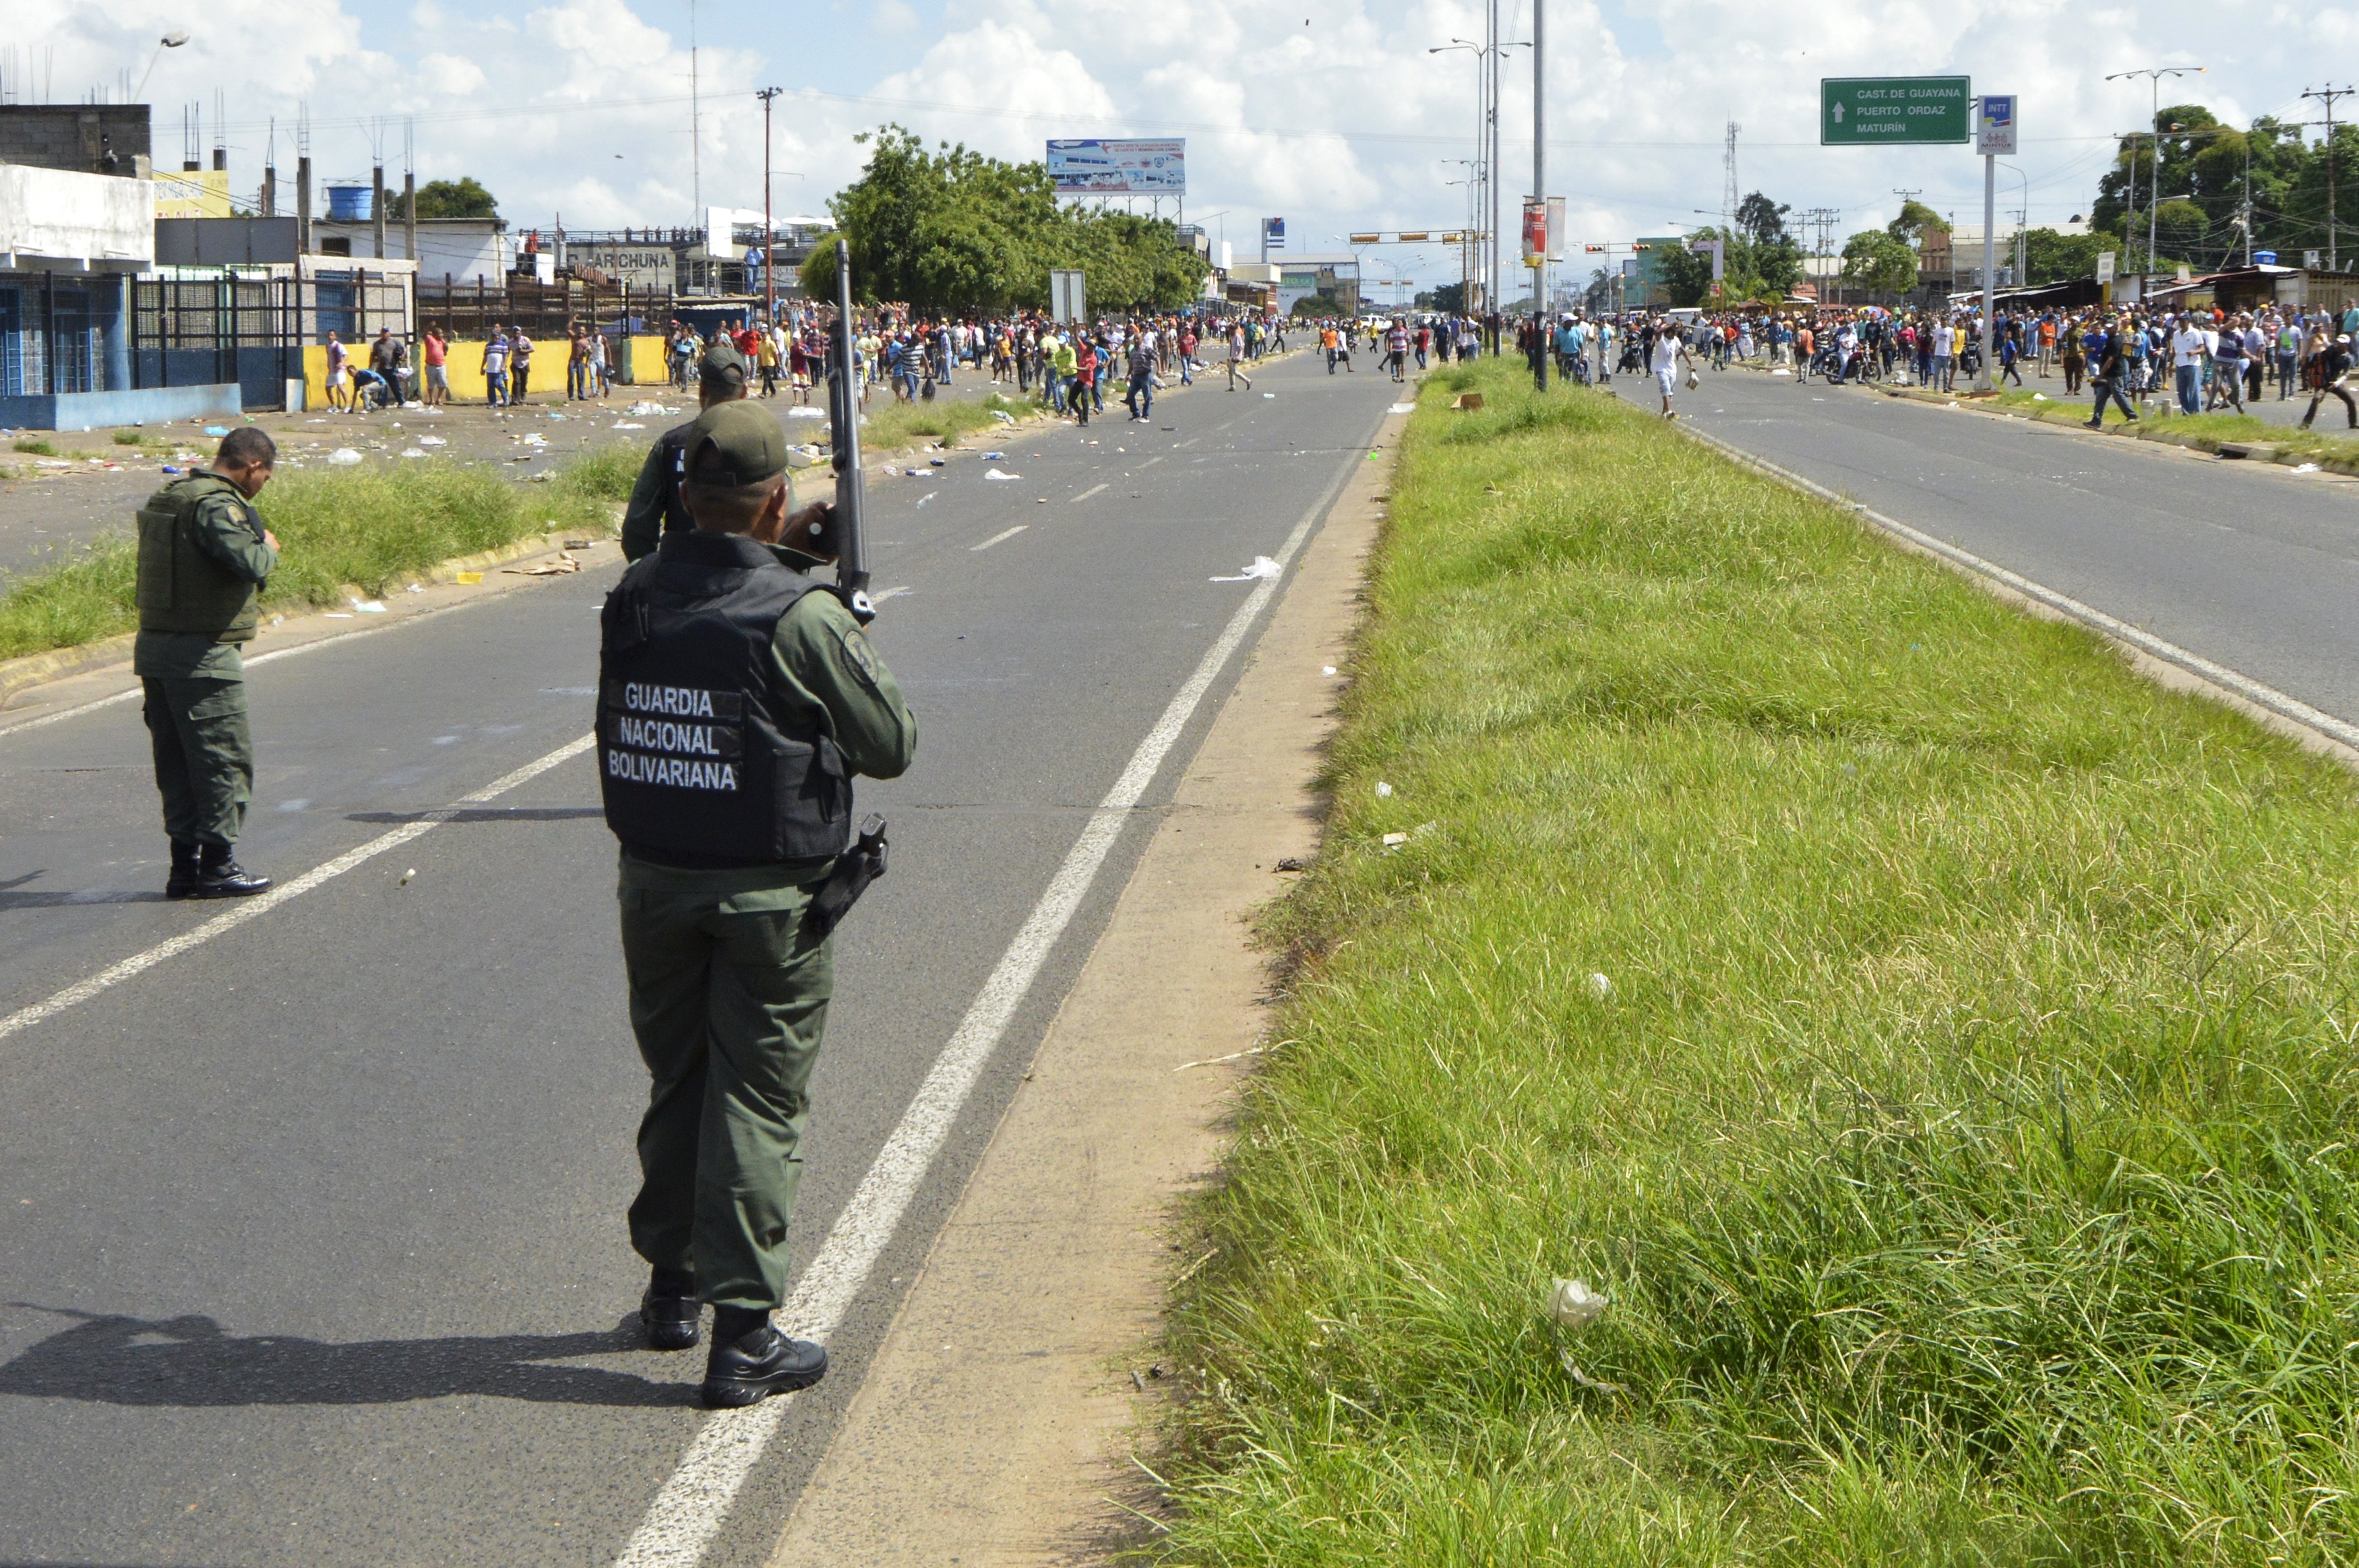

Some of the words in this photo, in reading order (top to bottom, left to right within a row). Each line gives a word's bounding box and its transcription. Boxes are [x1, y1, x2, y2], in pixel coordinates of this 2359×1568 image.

[1858, 90, 1887, 99] CAST.
[1891, 89, 1905, 98] DE
[1909, 88, 1961, 98] GUAYANA
[1857, 106, 1901, 116] PUERTO
[1907, 106, 1946, 115] ORDAZ
[1988, 104, 2006, 113] INTT
[1857, 121, 1906, 133] MATURÍN
[594, 253, 669, 268] ARCHUNA
[625, 681, 714, 717] GUARDIA
[620, 716, 720, 755] NACIONAL
[608, 749, 737, 791] BOLIVARIANA
